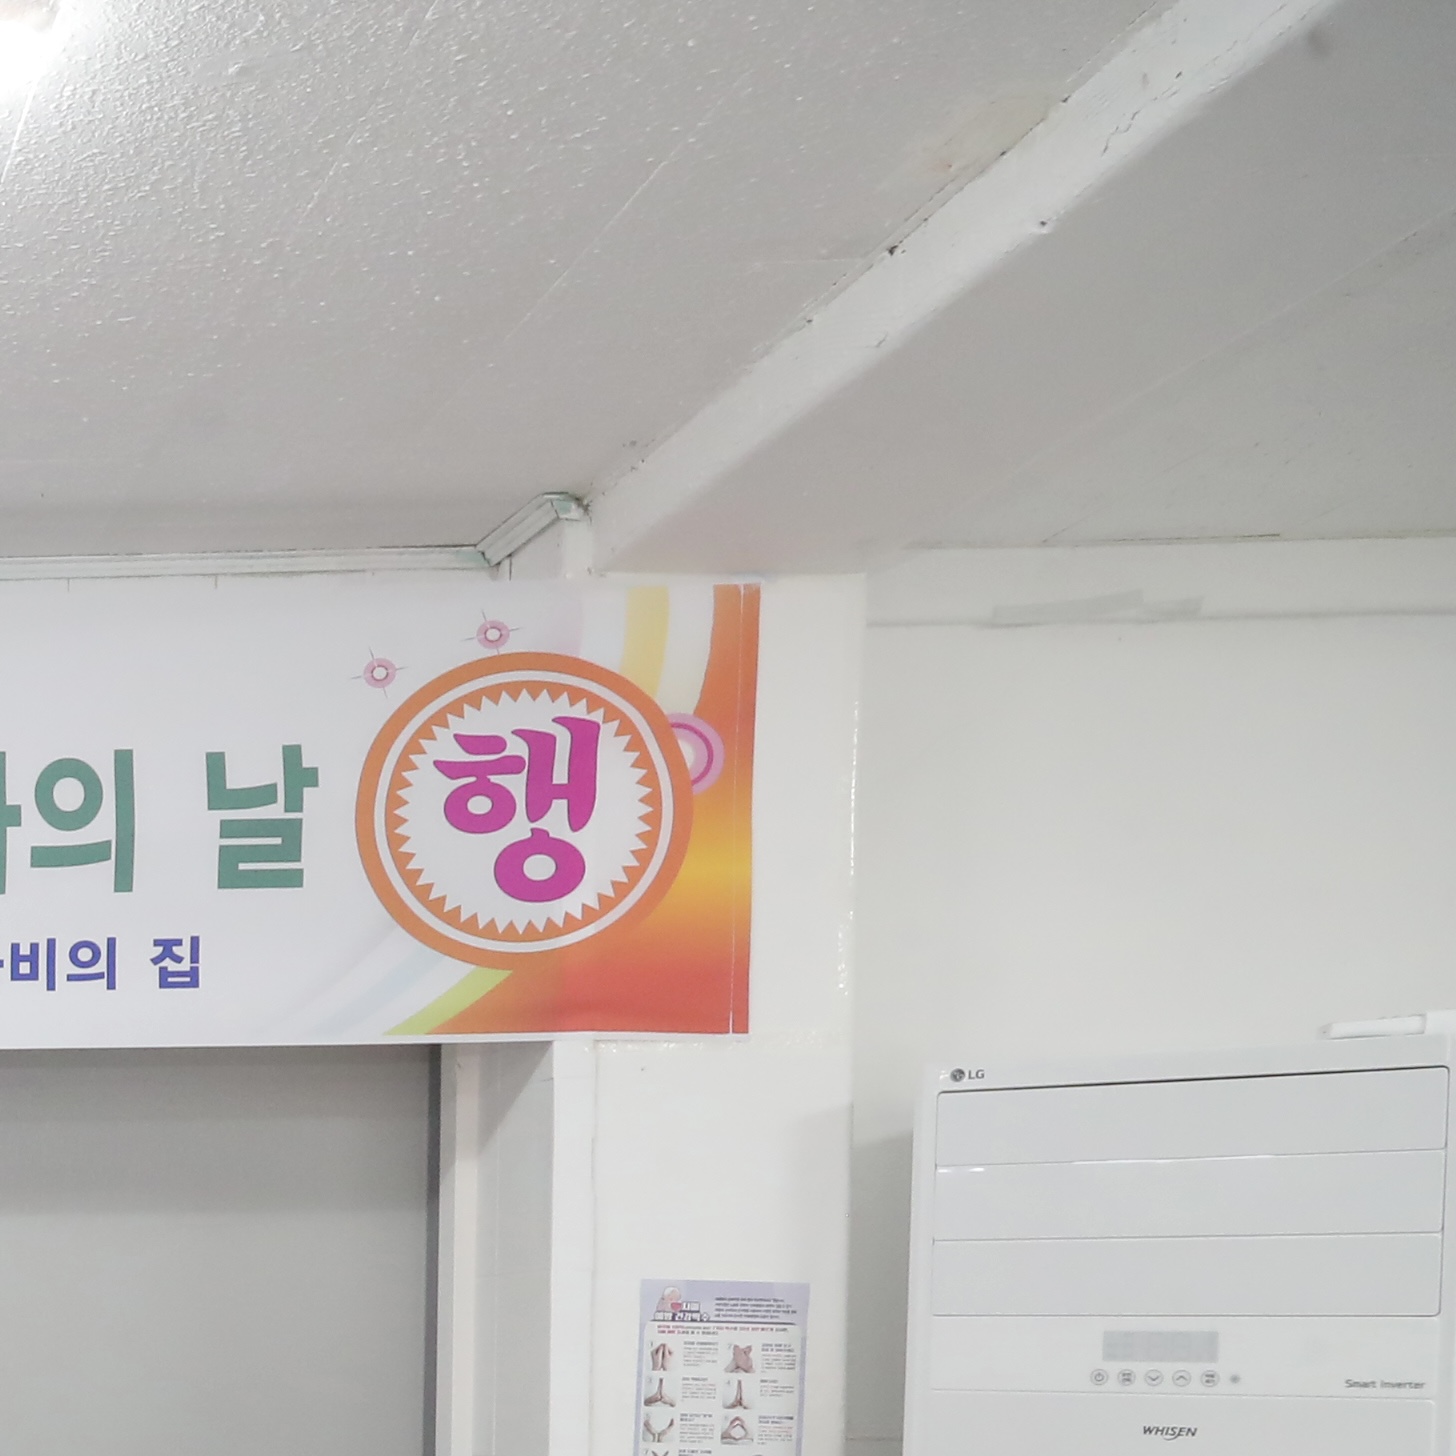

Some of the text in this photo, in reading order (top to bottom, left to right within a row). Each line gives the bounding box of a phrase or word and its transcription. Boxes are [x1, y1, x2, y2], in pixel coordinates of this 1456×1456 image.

[206, 745, 318, 889] 날
[433, 715, 601, 904] 행
[150, 936, 199, 989] 집
[969, 1070, 984, 1079] LG
[1345, 1379, 1425, 1389] Smart Inverter
[1144, 1426, 1197, 1439] WHISEN
